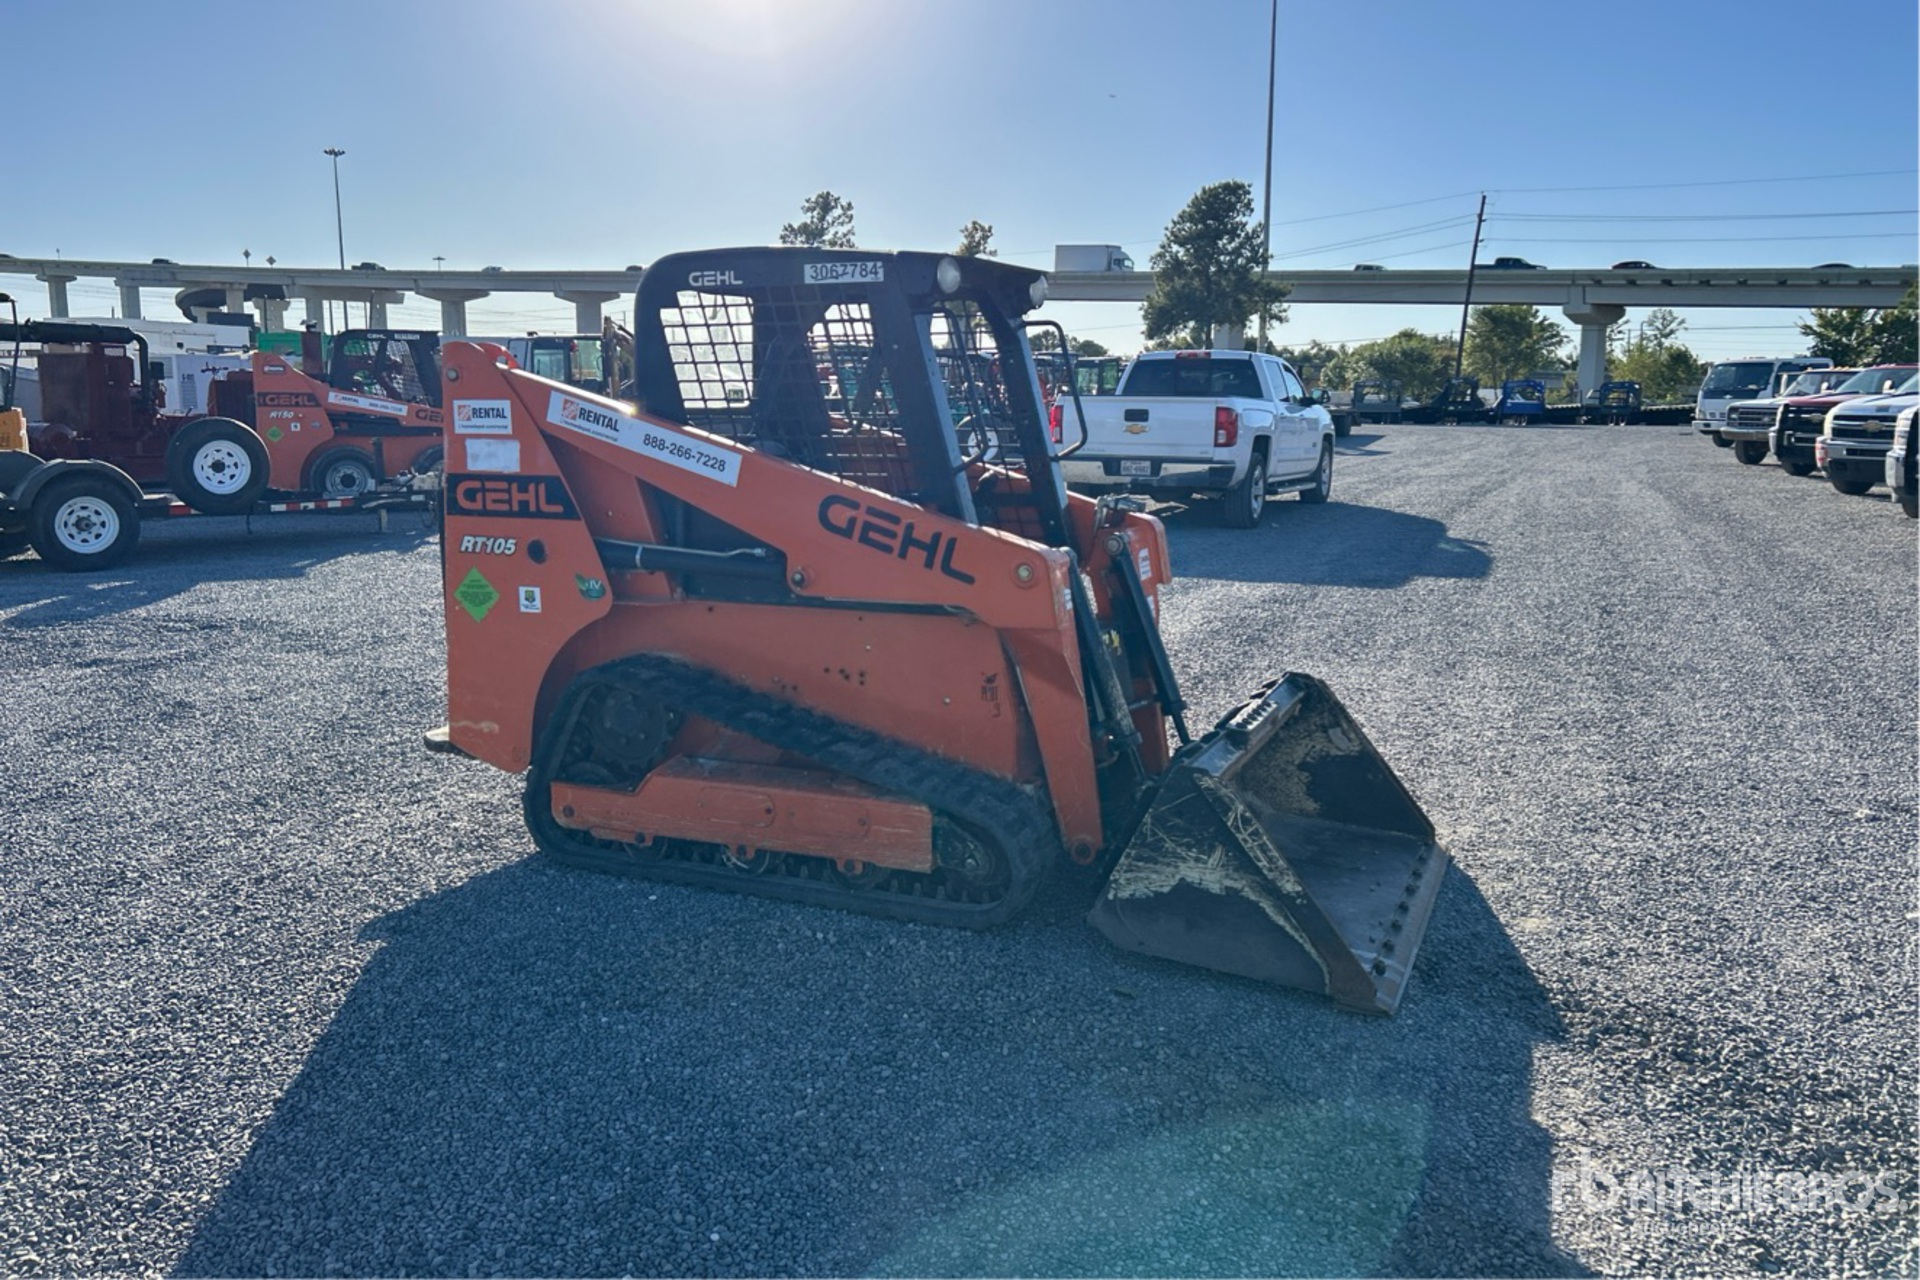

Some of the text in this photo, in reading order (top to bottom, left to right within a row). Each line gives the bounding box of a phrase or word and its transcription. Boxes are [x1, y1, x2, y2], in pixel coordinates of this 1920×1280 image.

[688, 270, 744, 287] GEHL
[809, 262, 880, 281] 3067784
[265, 393, 316, 406] GEHL
[471, 407, 508, 419] RENTAL
[578, 406, 620, 433] RENTAL
[642, 433, 727, 473] 888-266-7228
[456, 479, 565, 513] GEHL
[460, 535, 518, 556] RT105
[818, 494, 976, 585] GEHL
